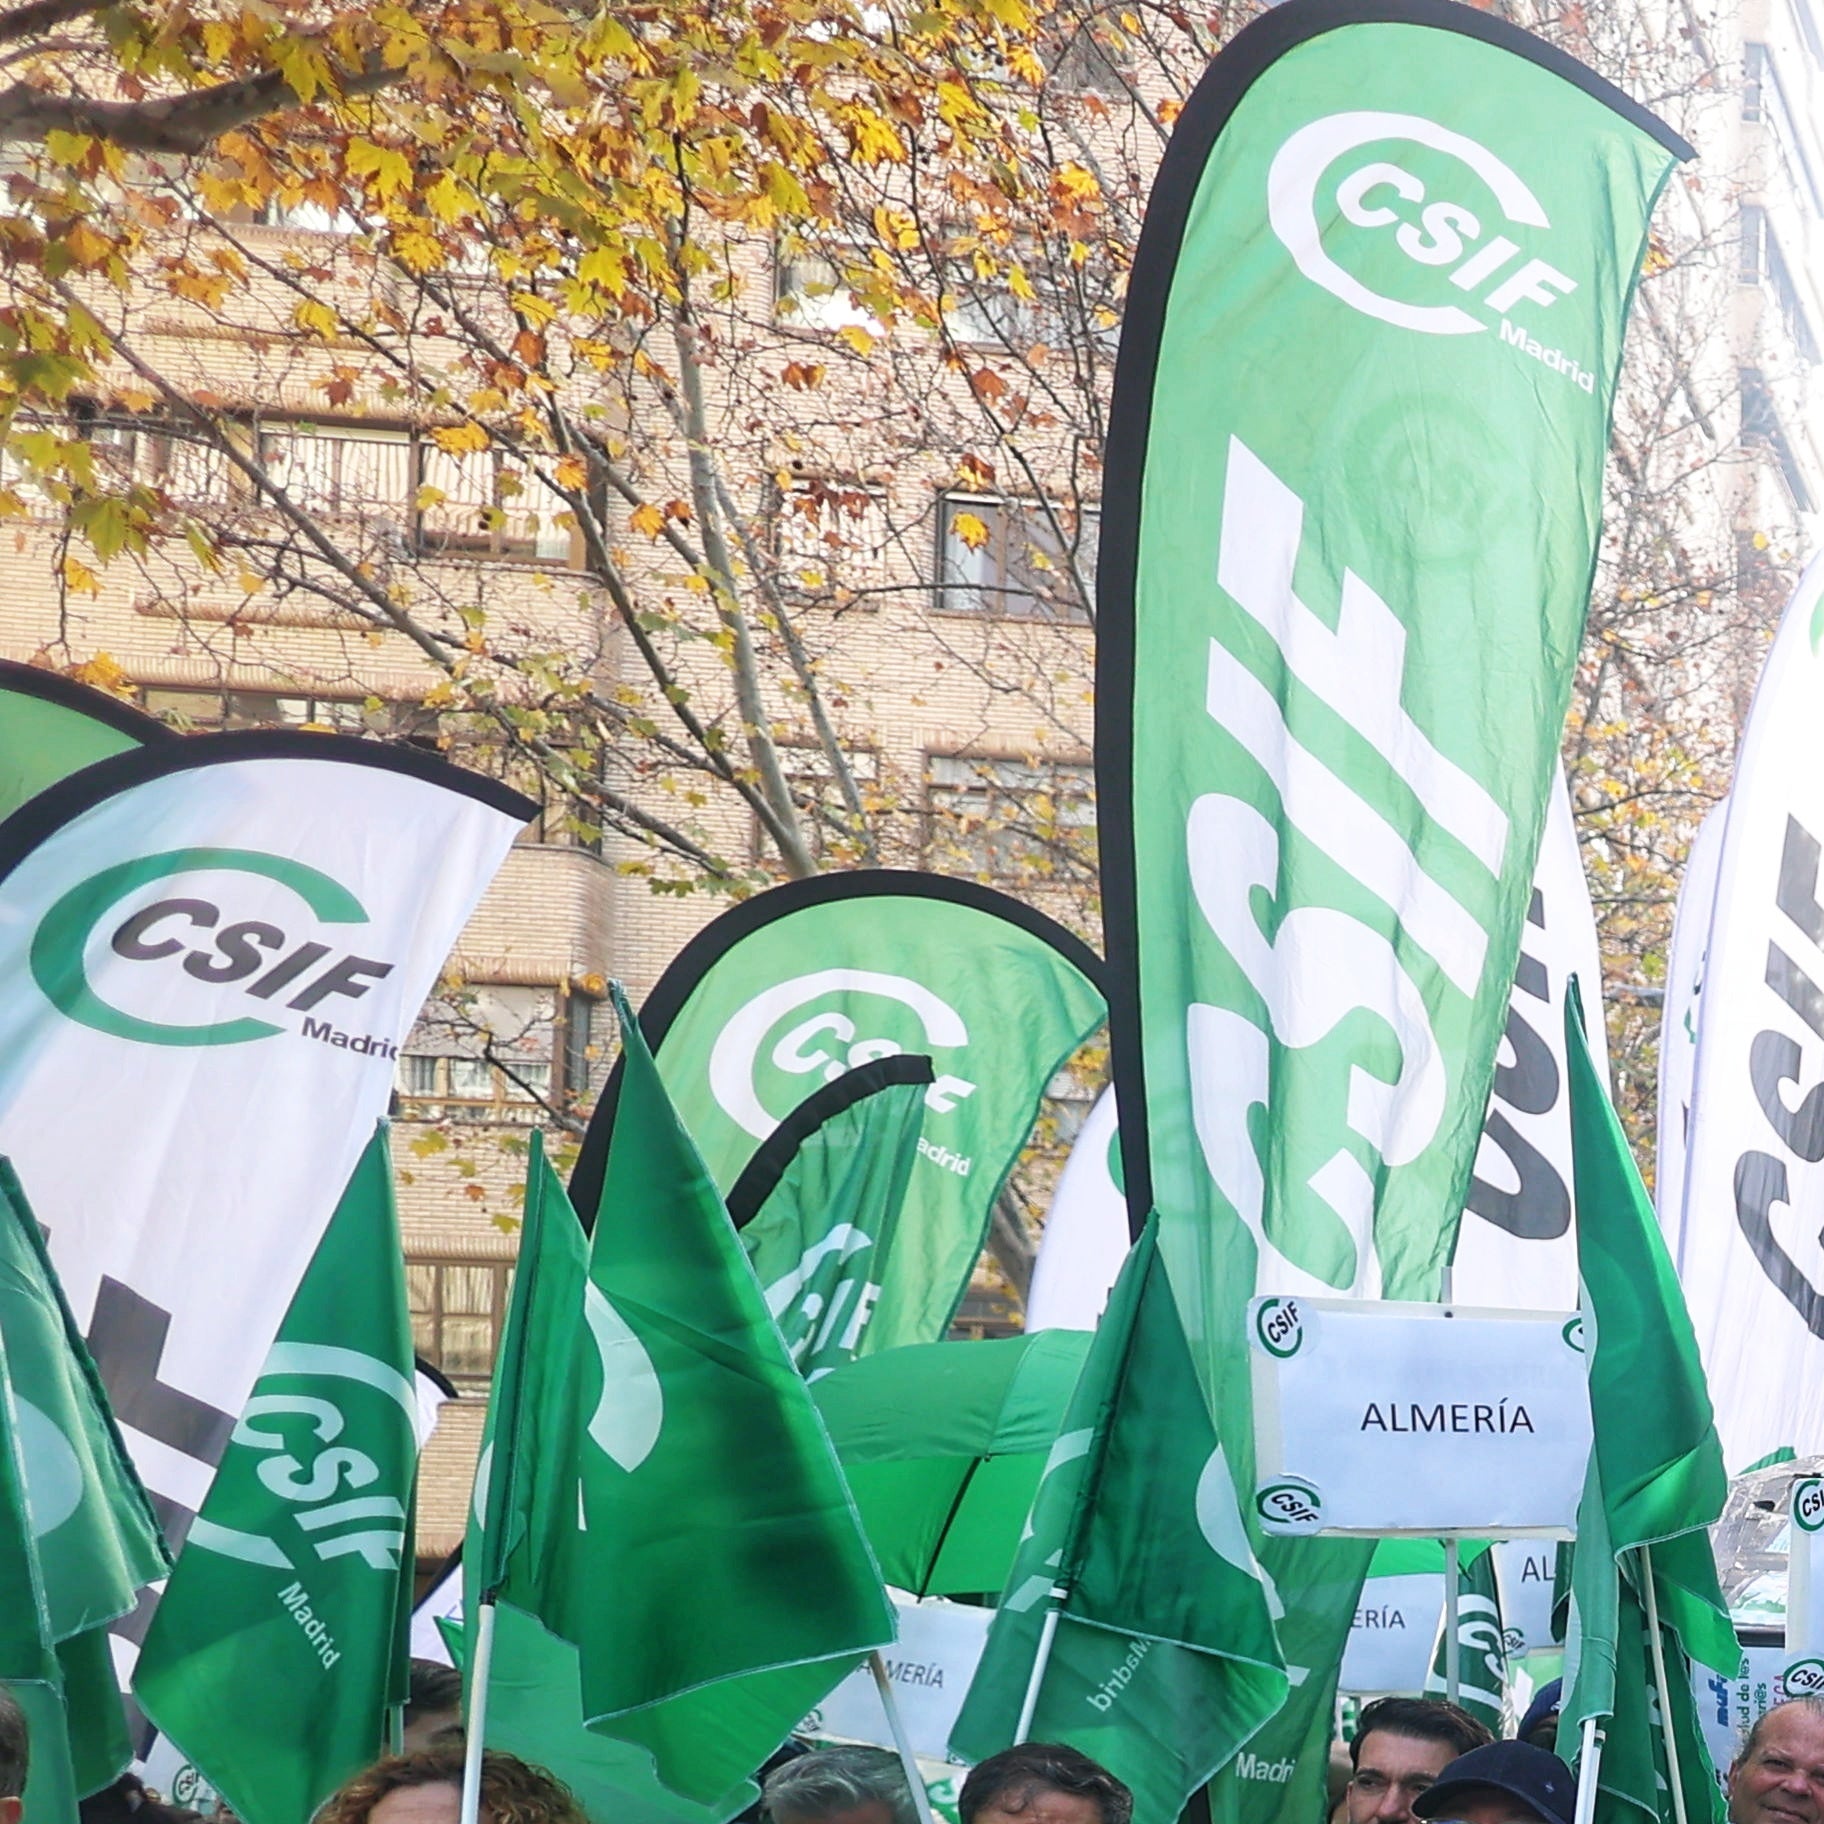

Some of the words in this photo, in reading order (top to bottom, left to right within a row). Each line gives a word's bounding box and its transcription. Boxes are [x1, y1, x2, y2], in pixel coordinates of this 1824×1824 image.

[1336, 161, 1579, 314] CSIF
[1498, 317, 1596, 395] Madrid
[112, 897, 394, 1012] CSIF
[915, 1136, 972, 1179] adrid
[1266, 1299, 1299, 1345] CSIF
[1360, 1397, 1535, 1434] ALMERÍA
[1271, 1492, 1321, 1525] CSIF
[277, 1581, 342, 1671] Madrid
[856, 1659, 944, 1688] AMERÍA
[1235, 1751, 1296, 1783] Madri
